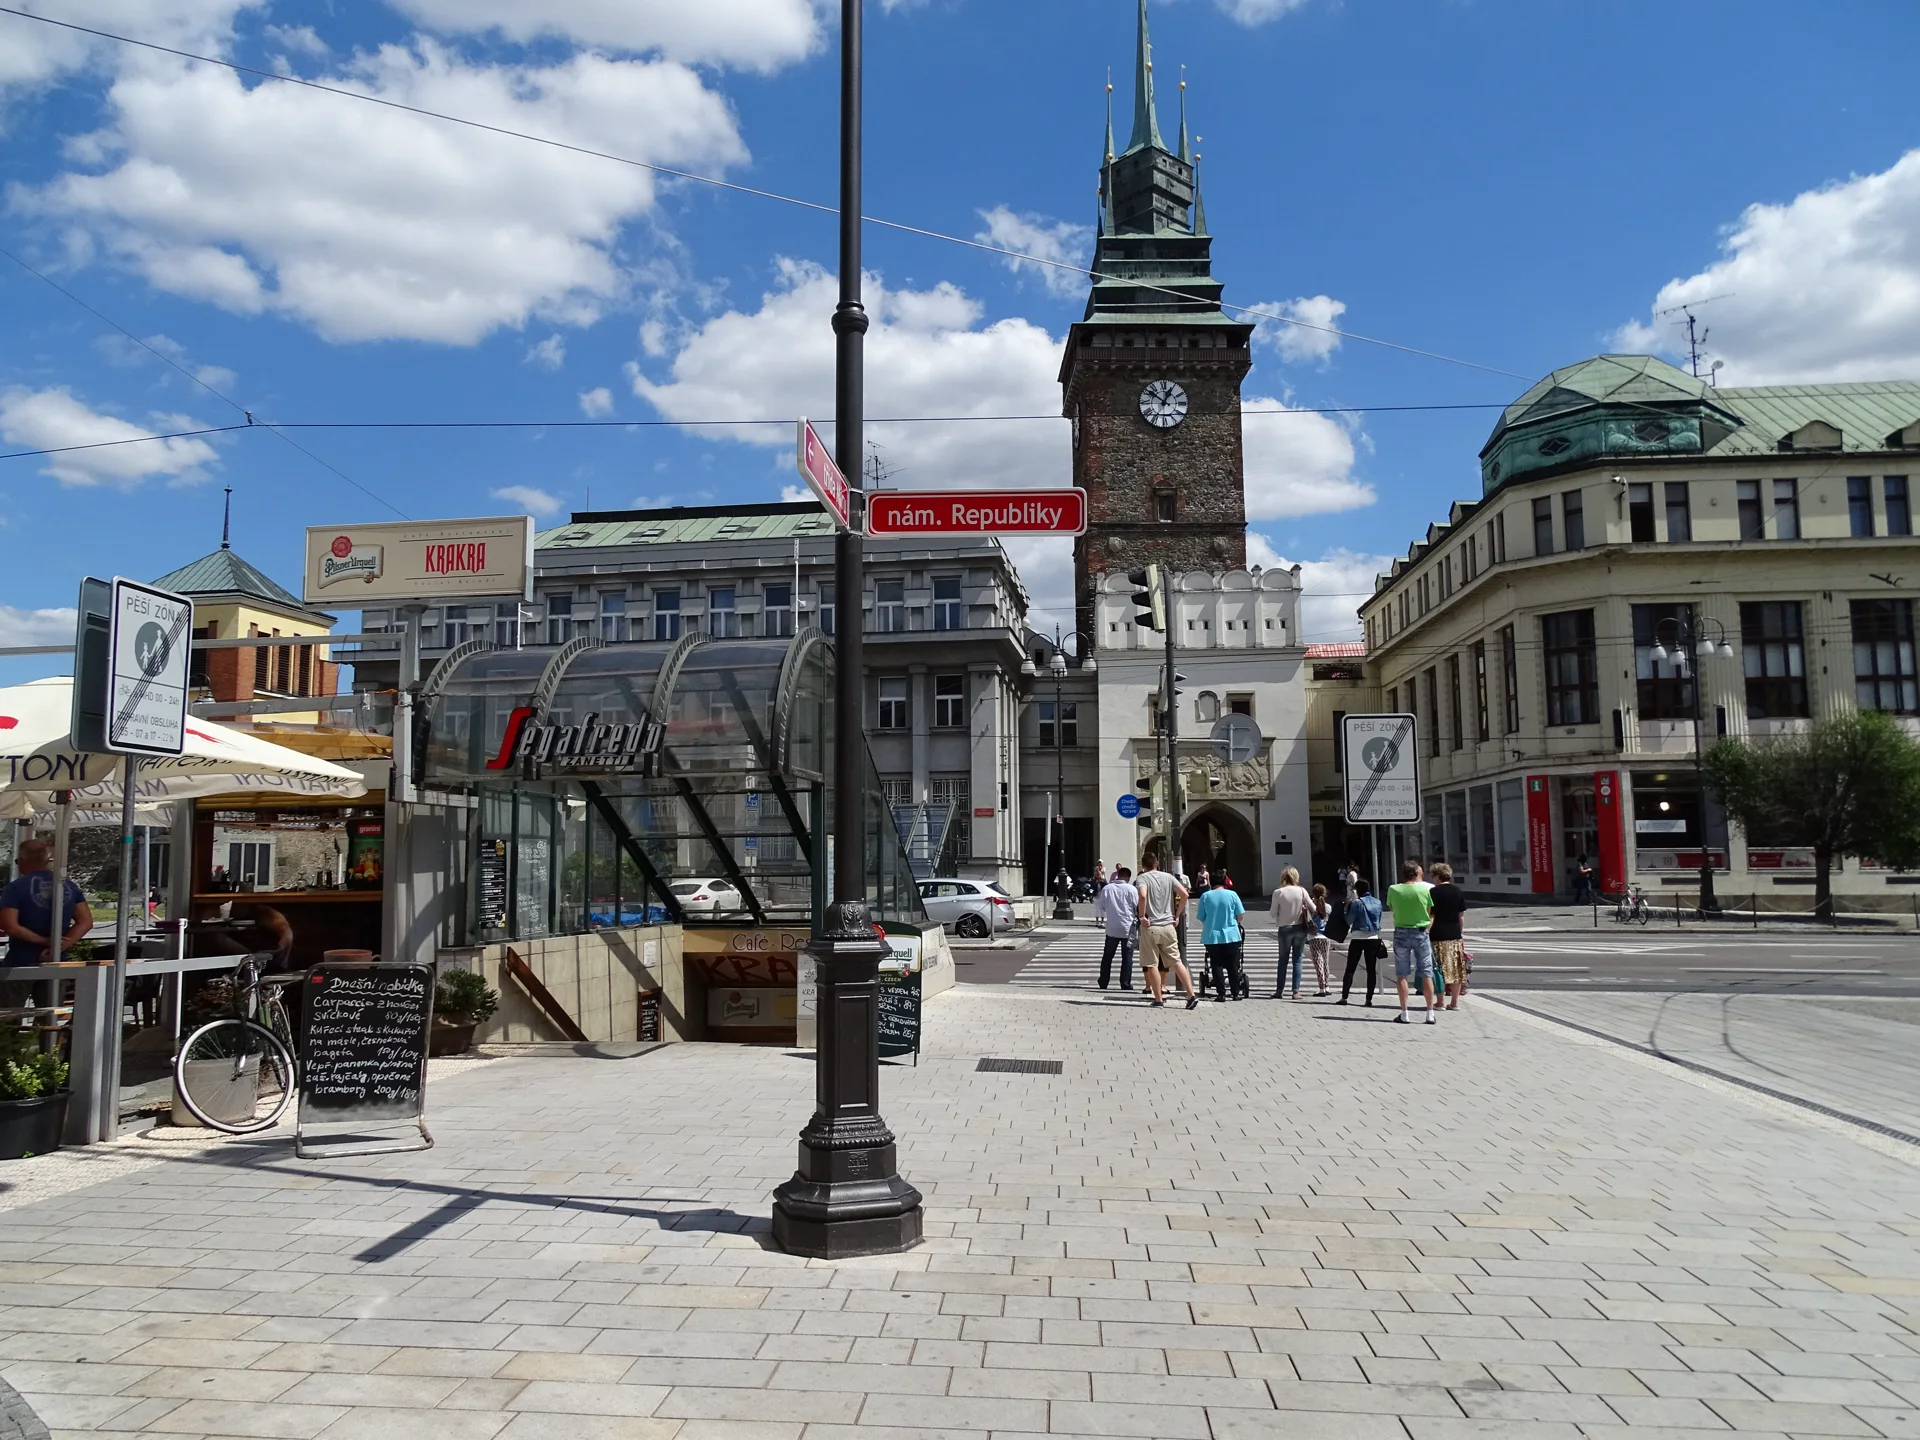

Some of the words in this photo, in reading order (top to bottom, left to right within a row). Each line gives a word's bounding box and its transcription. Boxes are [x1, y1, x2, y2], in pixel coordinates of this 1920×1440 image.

[887, 504, 942, 526] nám.
[951, 502, 1063, 530] Republiky
[425, 542, 486, 575] KRAKRA
[324, 557, 352, 578] Pilsner
[350, 556, 376, 571] Urquell
[126, 595, 151, 615] PĚŠÍ
[169, 696, 180, 706] 24h
[116, 710, 149, 725] DRAVNÍ
[150, 716, 179, 729] OBSLUHA
[1353, 720, 1376, 732] PĚŠÍ
[135, 728, 143, 738] 07
[150, 731, 156, 740] 17
[485, 706, 667, 770] Segafredo
[0, 753, 89, 783] TONI
[566, 756, 625, 767] ZANETTI
[359, 826, 381, 834] granini
[732, 933, 769, 951] Café
[780, 933, 812, 951] Res
[889, 947, 913, 963] rquell
[330, 977, 378, 990] Dnešní
[313, 1008, 365, 1021] svíčkové
[345, 1023, 374, 1034] steak
[309, 1038, 323, 1046] na
[313, 1047, 354, 1060] bageta
[314, 1083, 366, 1099] brambory
